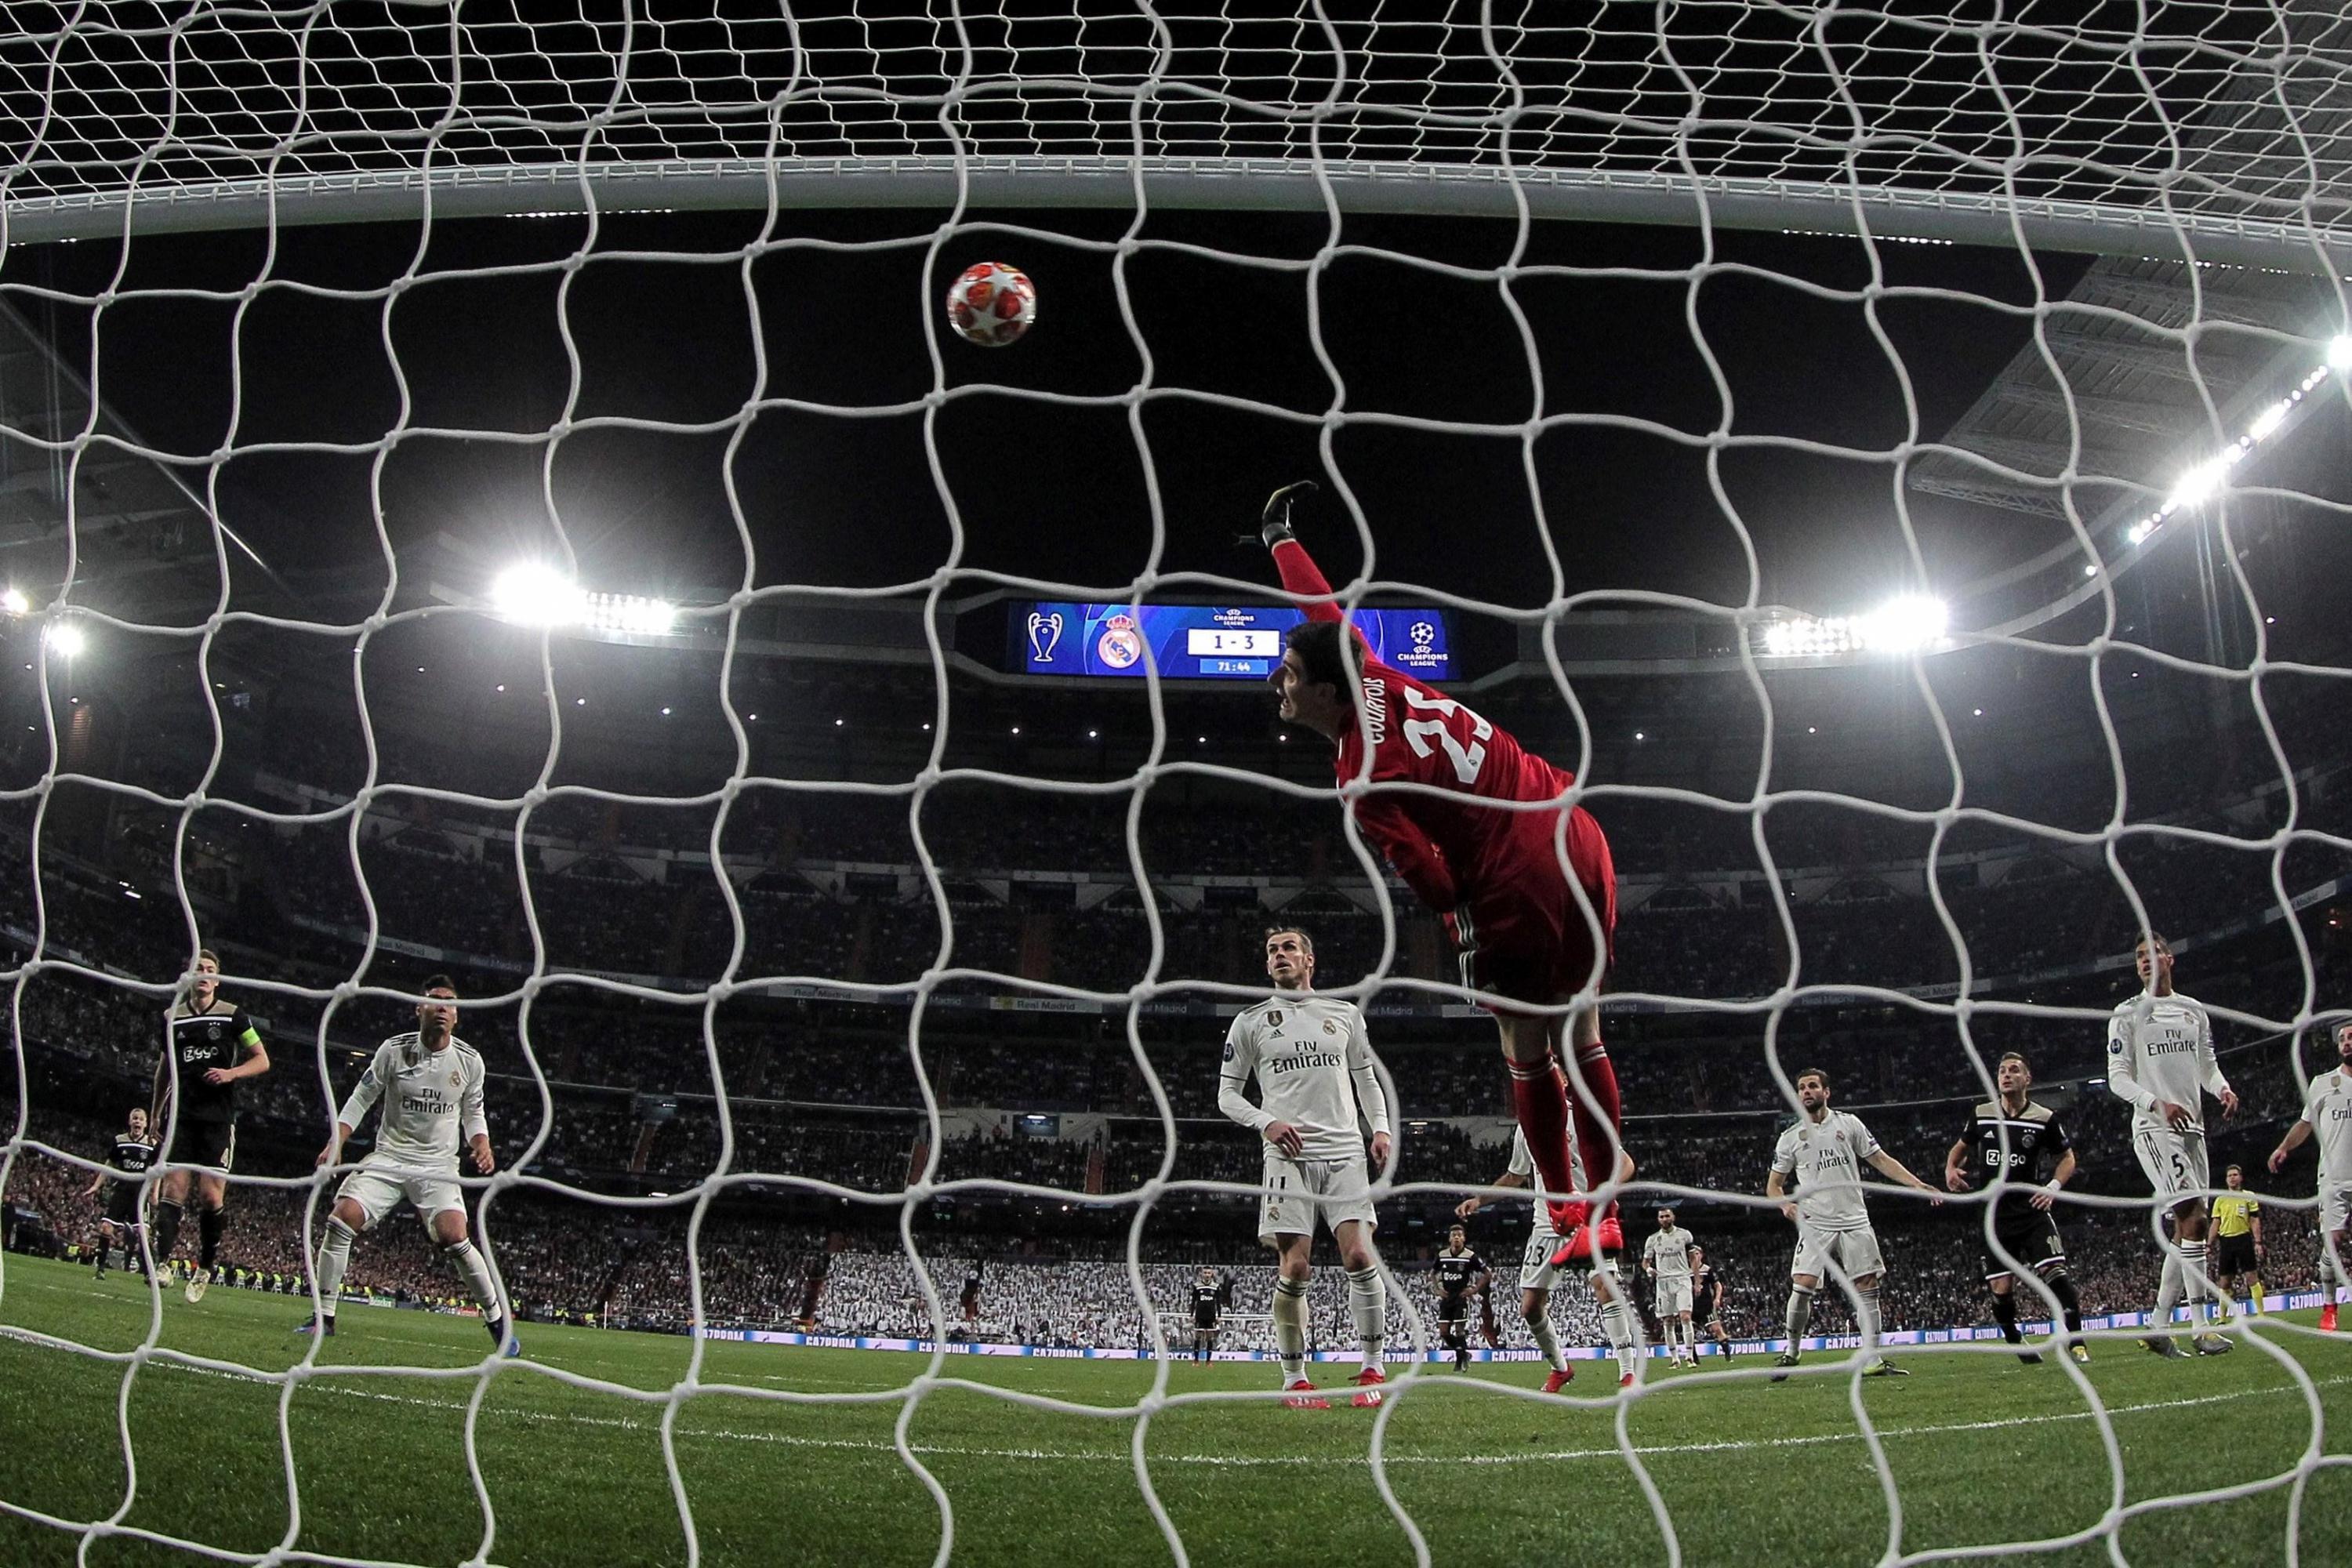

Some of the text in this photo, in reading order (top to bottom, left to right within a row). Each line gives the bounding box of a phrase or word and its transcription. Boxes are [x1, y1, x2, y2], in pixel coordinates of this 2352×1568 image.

[1218, 662, 1250, 672] 71:44
[1403, 684, 1494, 784] 25
[1018, 1000, 1076, 1011] Real Madrid
[1155, 1004, 1187, 1014] Madrid
[1381, 1007, 1413, 1016] Madrid
[1606, 1004, 1637, 1012] Madrid
[2165, 1029, 2183, 1040] Fly
[1294, 1040, 1318, 1053] Fly
[2147, 1039, 2197, 1057] Emirate
[1272, 1052, 1341, 1074] Emirates
[423, 1087, 441, 1101] Fly
[220, 1147, 229, 1167] 4
[1986, 1149, 2026, 1167] Zigo
[2171, 1153, 2184, 1179] 5
[1266, 1176, 1286, 1204] 11
[1524, 1245, 1544, 1267] 23
[703, 1328, 744, 1341] AZPROM
[919, 1341, 970, 1355] GAZROM
[1716, 1342, 1766, 1356] GZPROM
[1825, 1336, 1863, 1349] GAZPRO
[1491, 1349, 1542, 1363] GAZPROM
